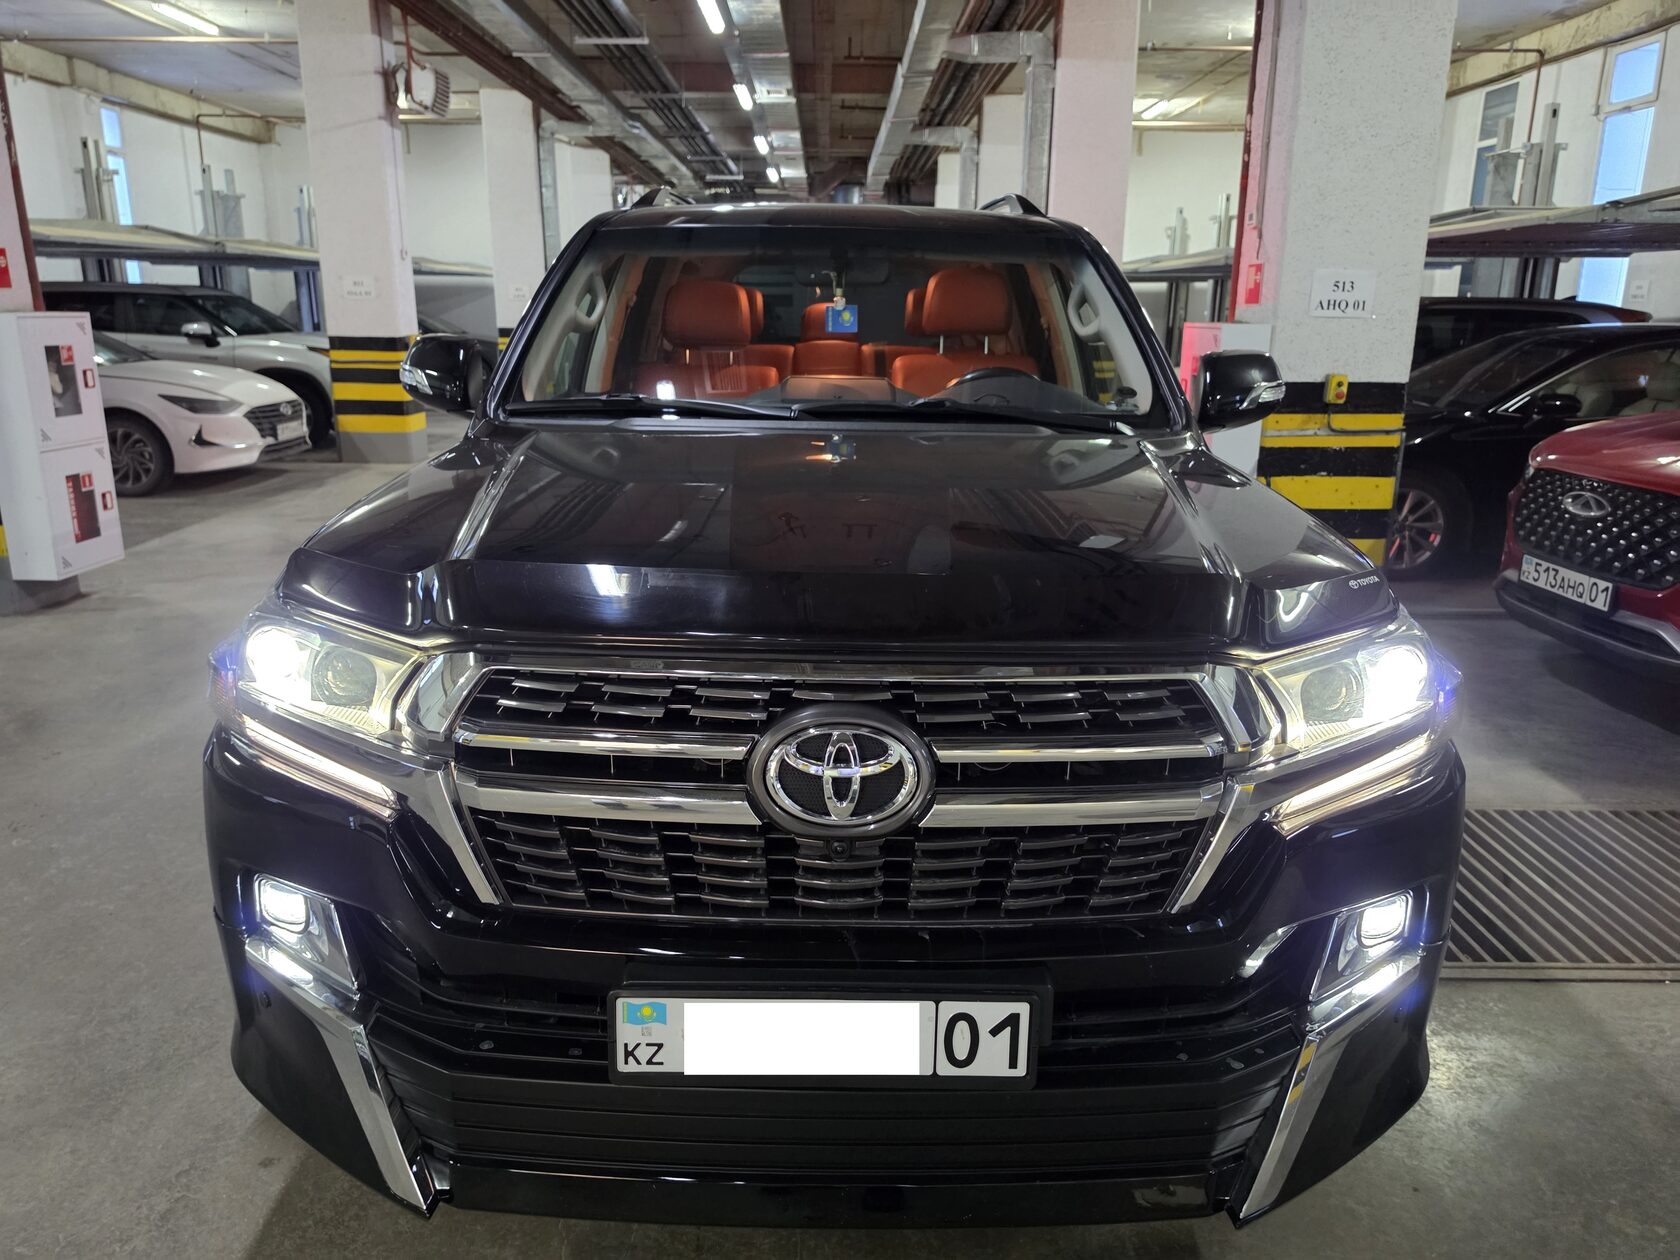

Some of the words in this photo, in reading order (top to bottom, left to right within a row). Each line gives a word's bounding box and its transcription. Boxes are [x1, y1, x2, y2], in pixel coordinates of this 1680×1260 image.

[1332, 280, 1354, 292] 513
[1315, 299, 1348, 313] AHQ
[1353, 299, 1366, 311] 01
[1357, 575, 1380, 586] TOYOTA
[1532, 562, 1585, 599] 513AHQ
[1588, 581, 1610, 608] 01
[623, 1042, 664, 1066] KZ
[943, 1011, 1021, 1070] 01
